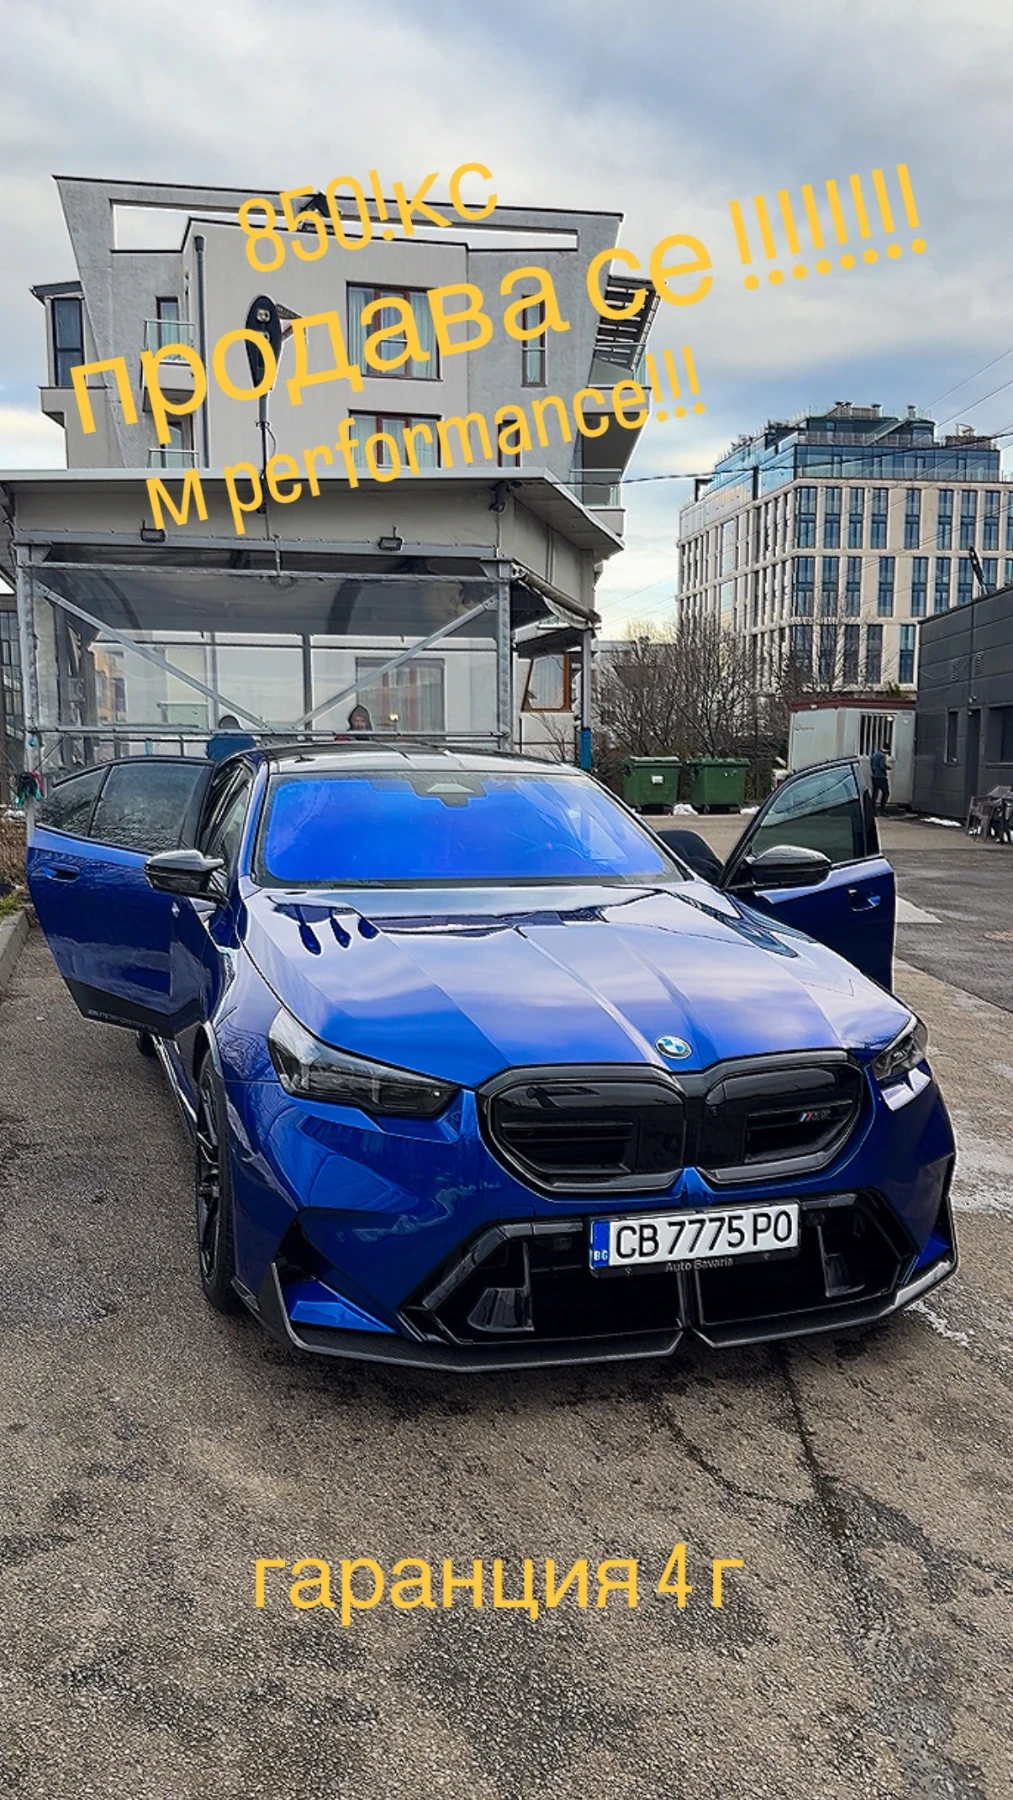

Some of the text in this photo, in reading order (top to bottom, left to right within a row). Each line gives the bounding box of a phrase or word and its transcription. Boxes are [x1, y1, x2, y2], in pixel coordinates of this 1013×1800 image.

[667, 1215, 746, 1255] 7775
[664, 1257, 734, 1272] Auto Bavaria
